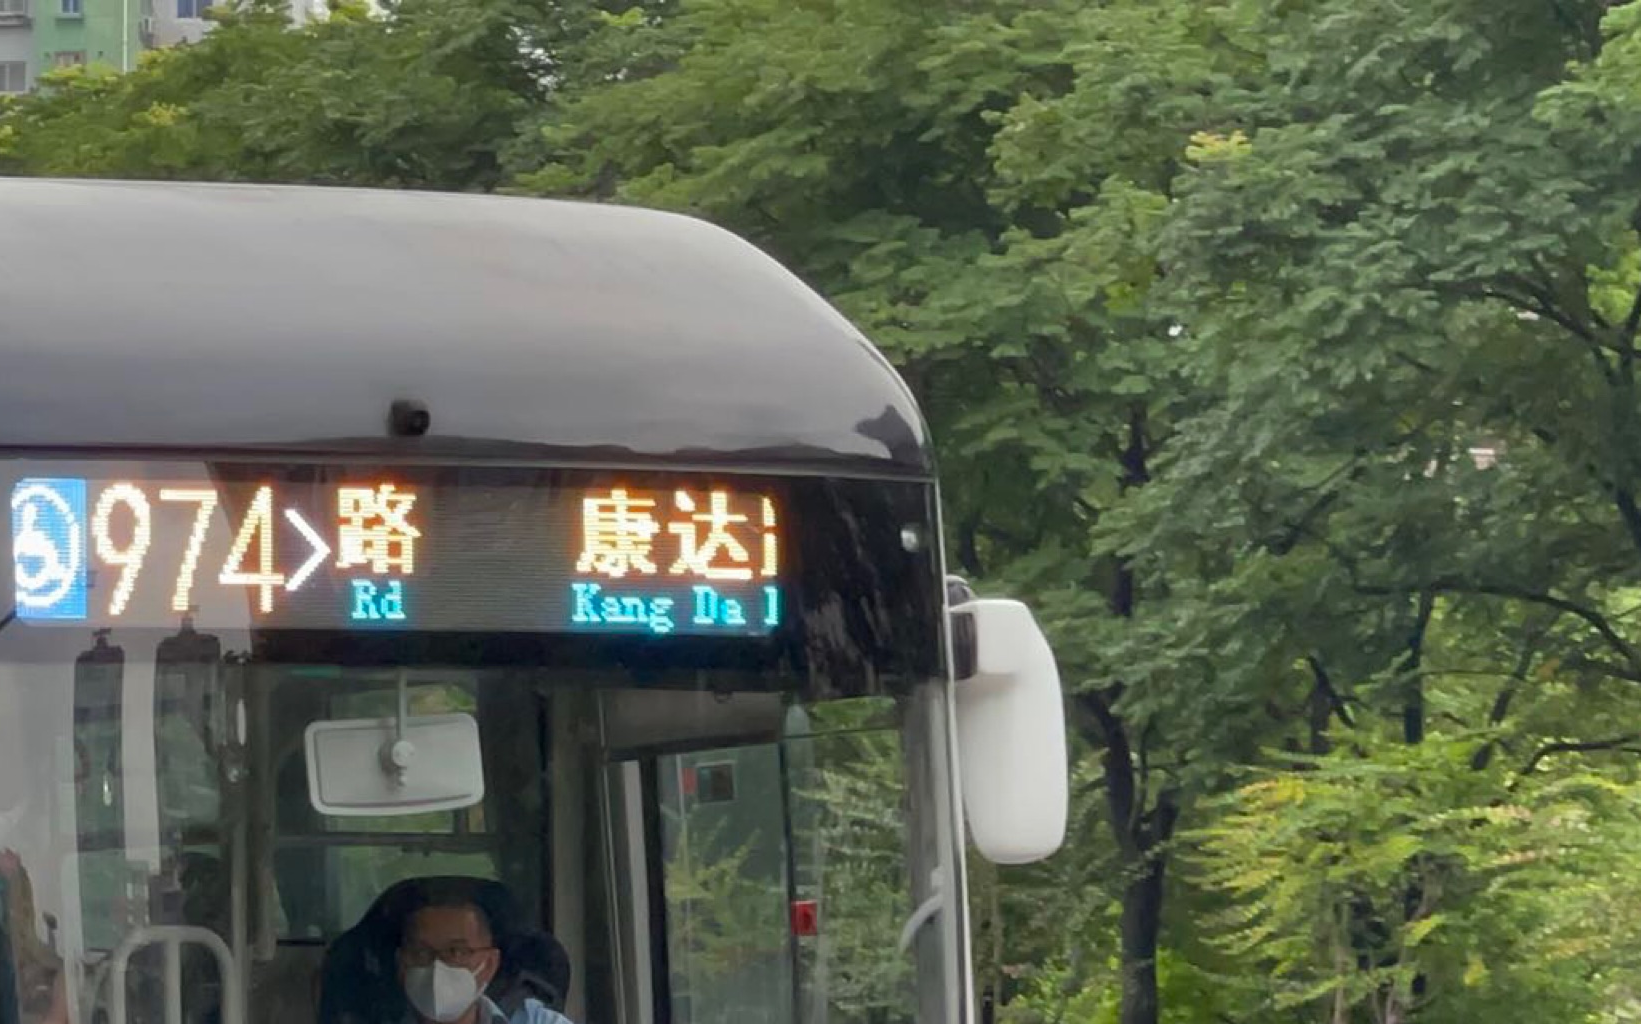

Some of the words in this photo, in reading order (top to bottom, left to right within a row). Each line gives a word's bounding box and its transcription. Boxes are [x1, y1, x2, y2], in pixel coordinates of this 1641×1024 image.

[92, 482, 285, 616] 974
[335, 484, 422, 574] 路
[351, 578, 407, 620] Rd
[571, 583, 675, 635] Kang
[691, 585, 747, 625] Da
